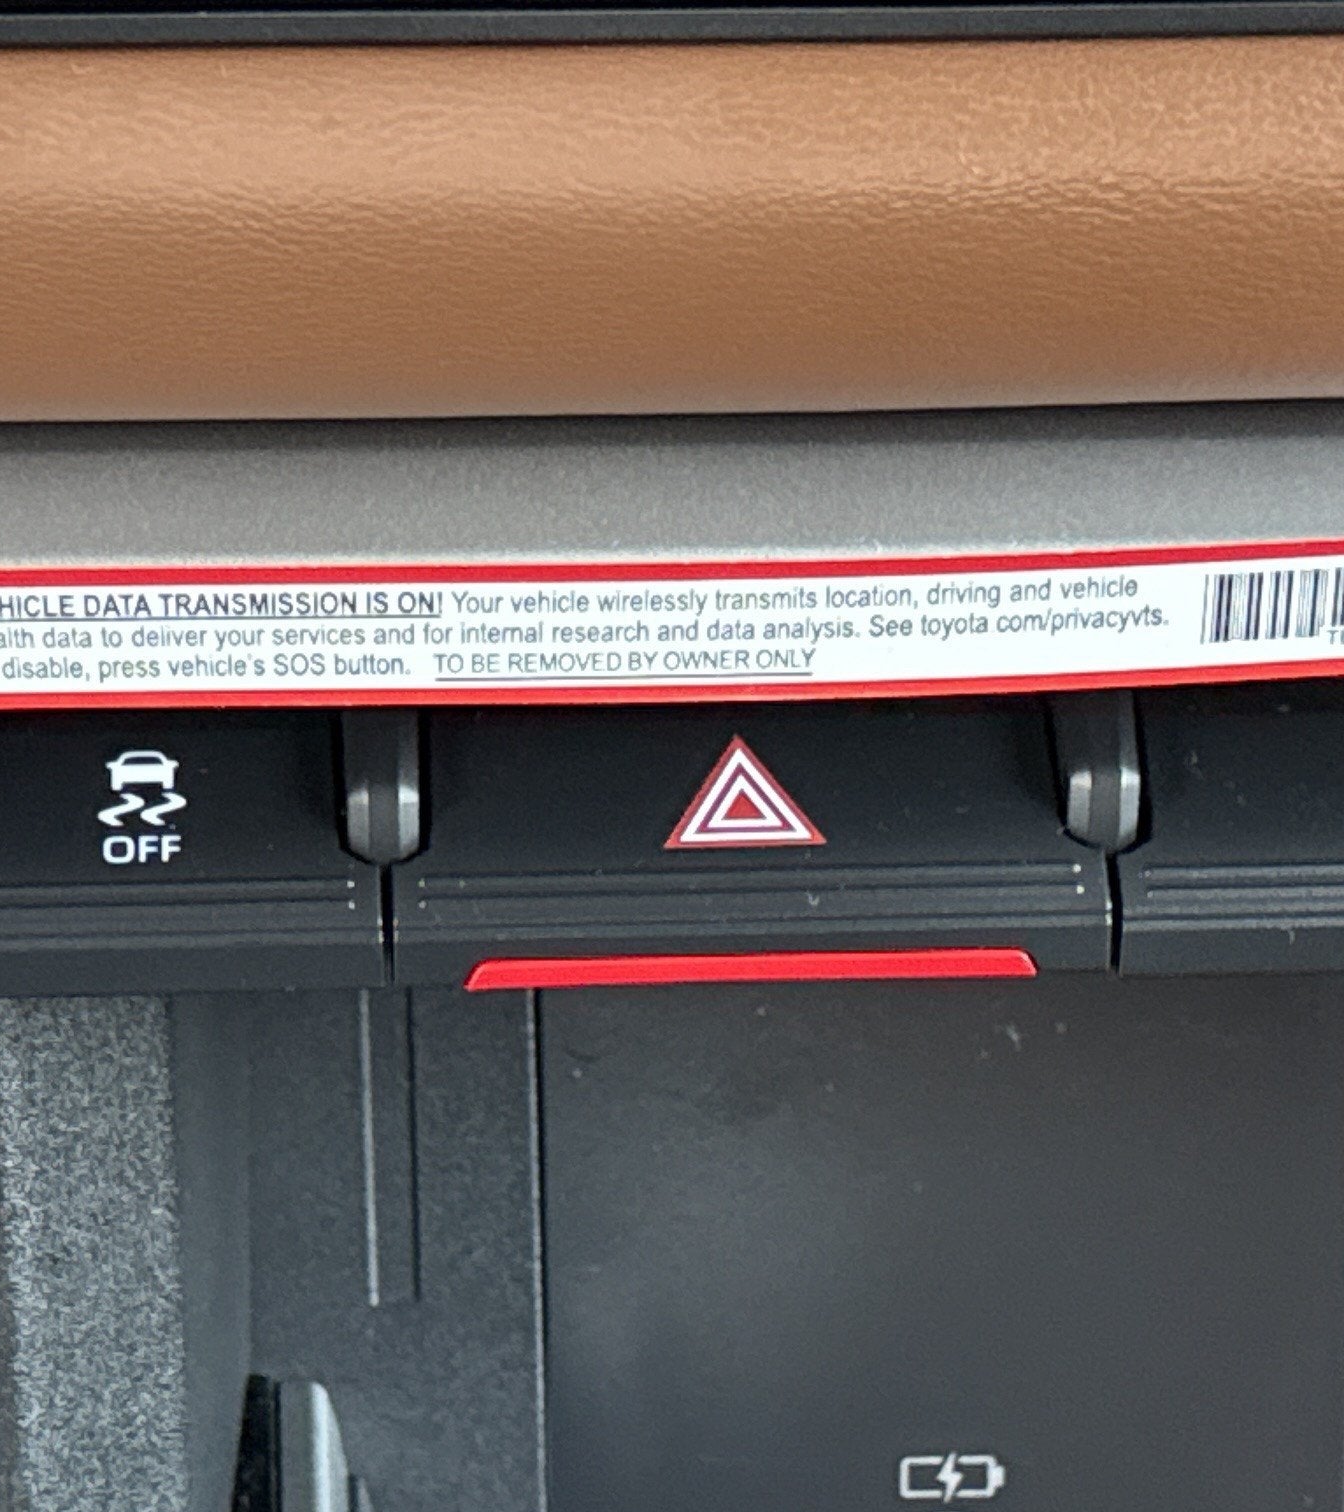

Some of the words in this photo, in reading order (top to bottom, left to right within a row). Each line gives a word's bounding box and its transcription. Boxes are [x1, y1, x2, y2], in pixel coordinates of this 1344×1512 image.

[84, 594, 152, 616] DATA
[158, 592, 356, 616] TRANSMISSION
[366, 592, 389, 614] IS
[453, 591, 501, 614] Your
[511, 590, 589, 613] vehicle
[596, 588, 708, 615] wirelessly
[714, 588, 817, 611] transmits
[825, 585, 918, 610] location,
[927, 581, 1001, 609] driving
[1009, 579, 1051, 601] and
[1061, 578, 1138, 598] vehicle
[42, 627, 92, 648] data
[100, 627, 123, 648] to
[131, 626, 207, 647] deliver
[214, 629, 265, 652] your
[272, 626, 365, 646] services
[374, 623, 414, 645] and
[423, 622, 453, 644] for
[461, 621, 543, 644] internal
[552, 620, 649, 643] research
[658, 619, 698, 641] and
[707, 619, 755, 641] data
[763, 617, 860, 645] analysis.
[869, 615, 913, 638] See
[921, 603, 1169, 641] toyotacom/privacyvts.
[2, 657, 90, 681] disable,
[98, 660, 160, 683] press
[167, 654, 265, 677] vehicle's
[274, 653, 325, 676] SOS
[334, 654, 410, 675] button.
[433, 653, 464, 674] TO
[472, 653, 500, 673] BE
[508, 652, 621, 673] REMOVED
[628, 651, 658, 671] BY
[663, 650, 749, 671] OWNER
[756, 648, 816, 669] ONLY
[103, 835, 181, 863] OFF
